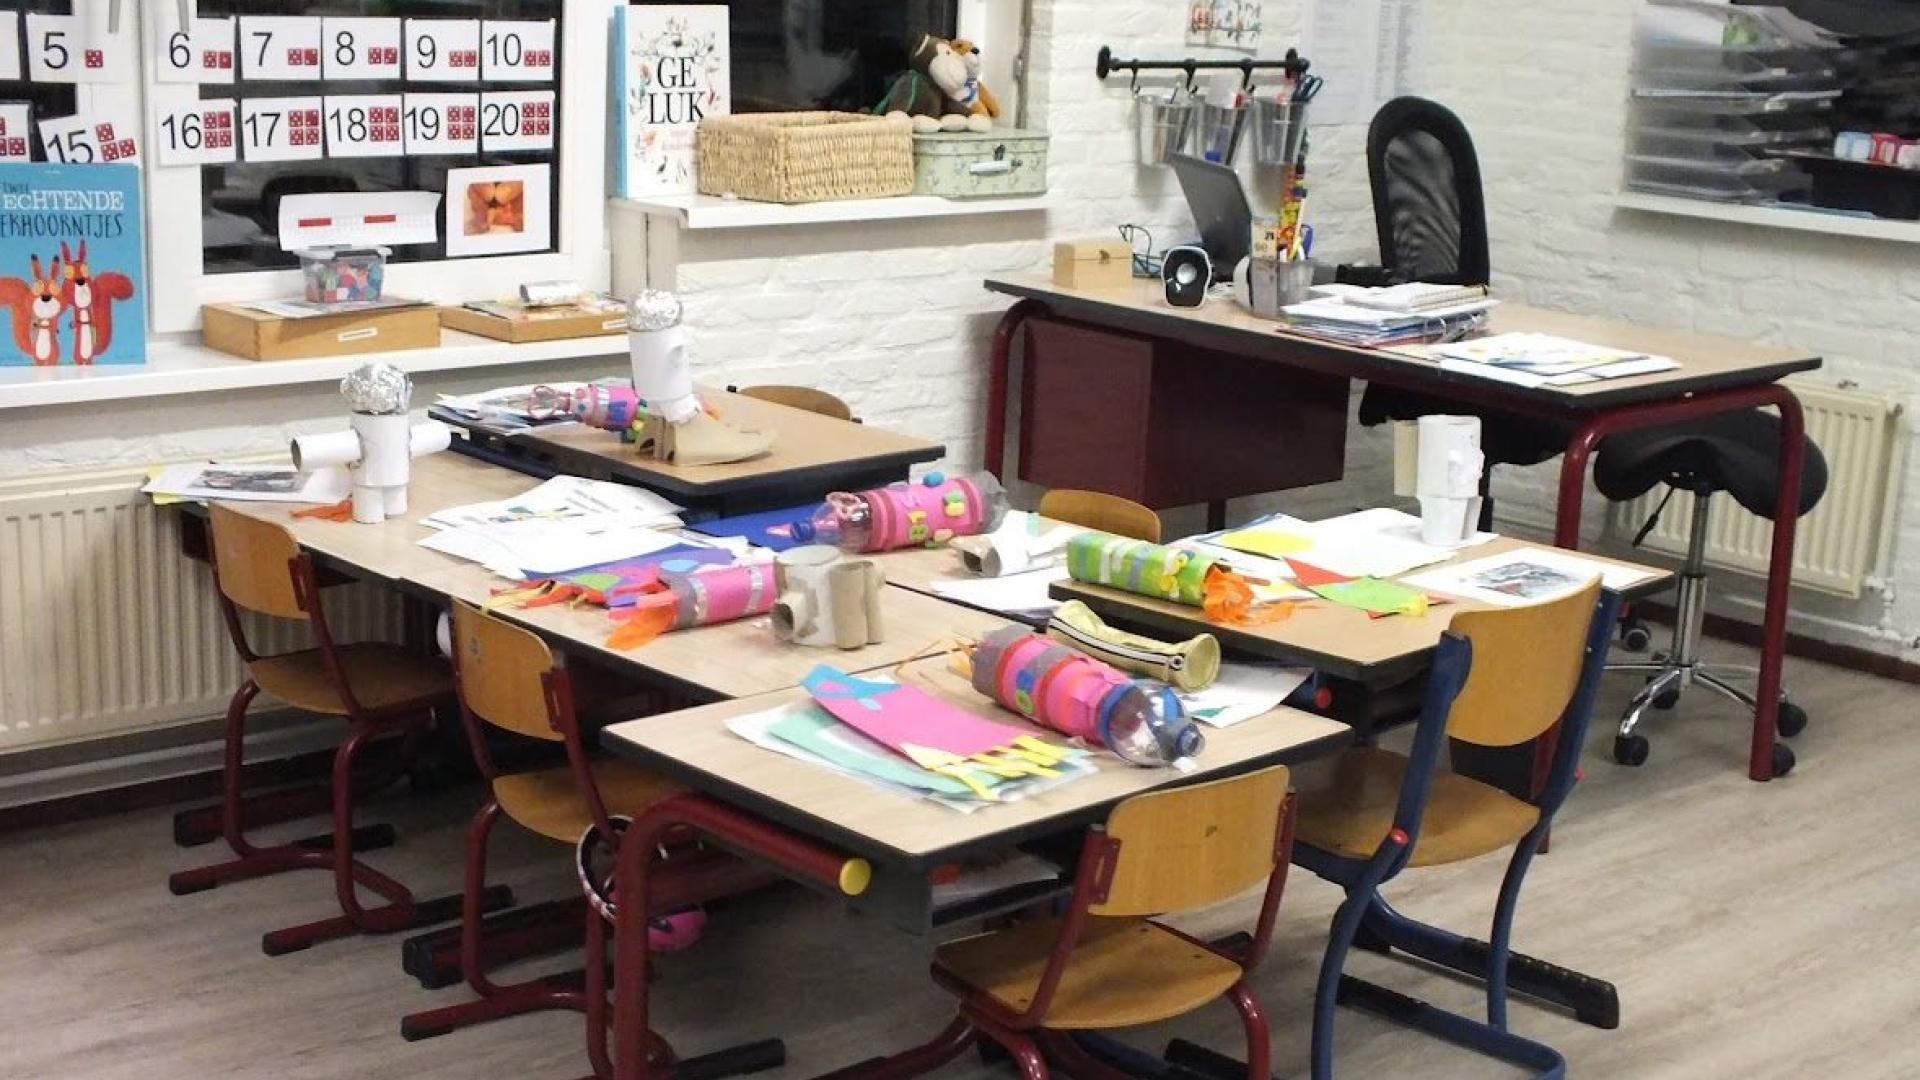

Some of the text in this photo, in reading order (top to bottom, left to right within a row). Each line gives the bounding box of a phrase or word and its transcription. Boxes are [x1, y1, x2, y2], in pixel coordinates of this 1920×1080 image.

[43, 32, 69, 69] 5
[169, 31, 191, 68] 6
[252, 31, 273, 67] 7
[335, 30, 356, 66] 8
[416, 34, 437, 69] 9
[486, 33, 522, 67] 10
[657, 56, 696, 88] GE
[329, 107, 367, 142] 18
[404, 106, 440, 140] 19
[483, 103, 520, 136] 20
[648, 91, 705, 124] LUK
[47, 129, 94, 164] 15
[161, 112, 201, 149] 16
[245, 112, 281, 147] 17
